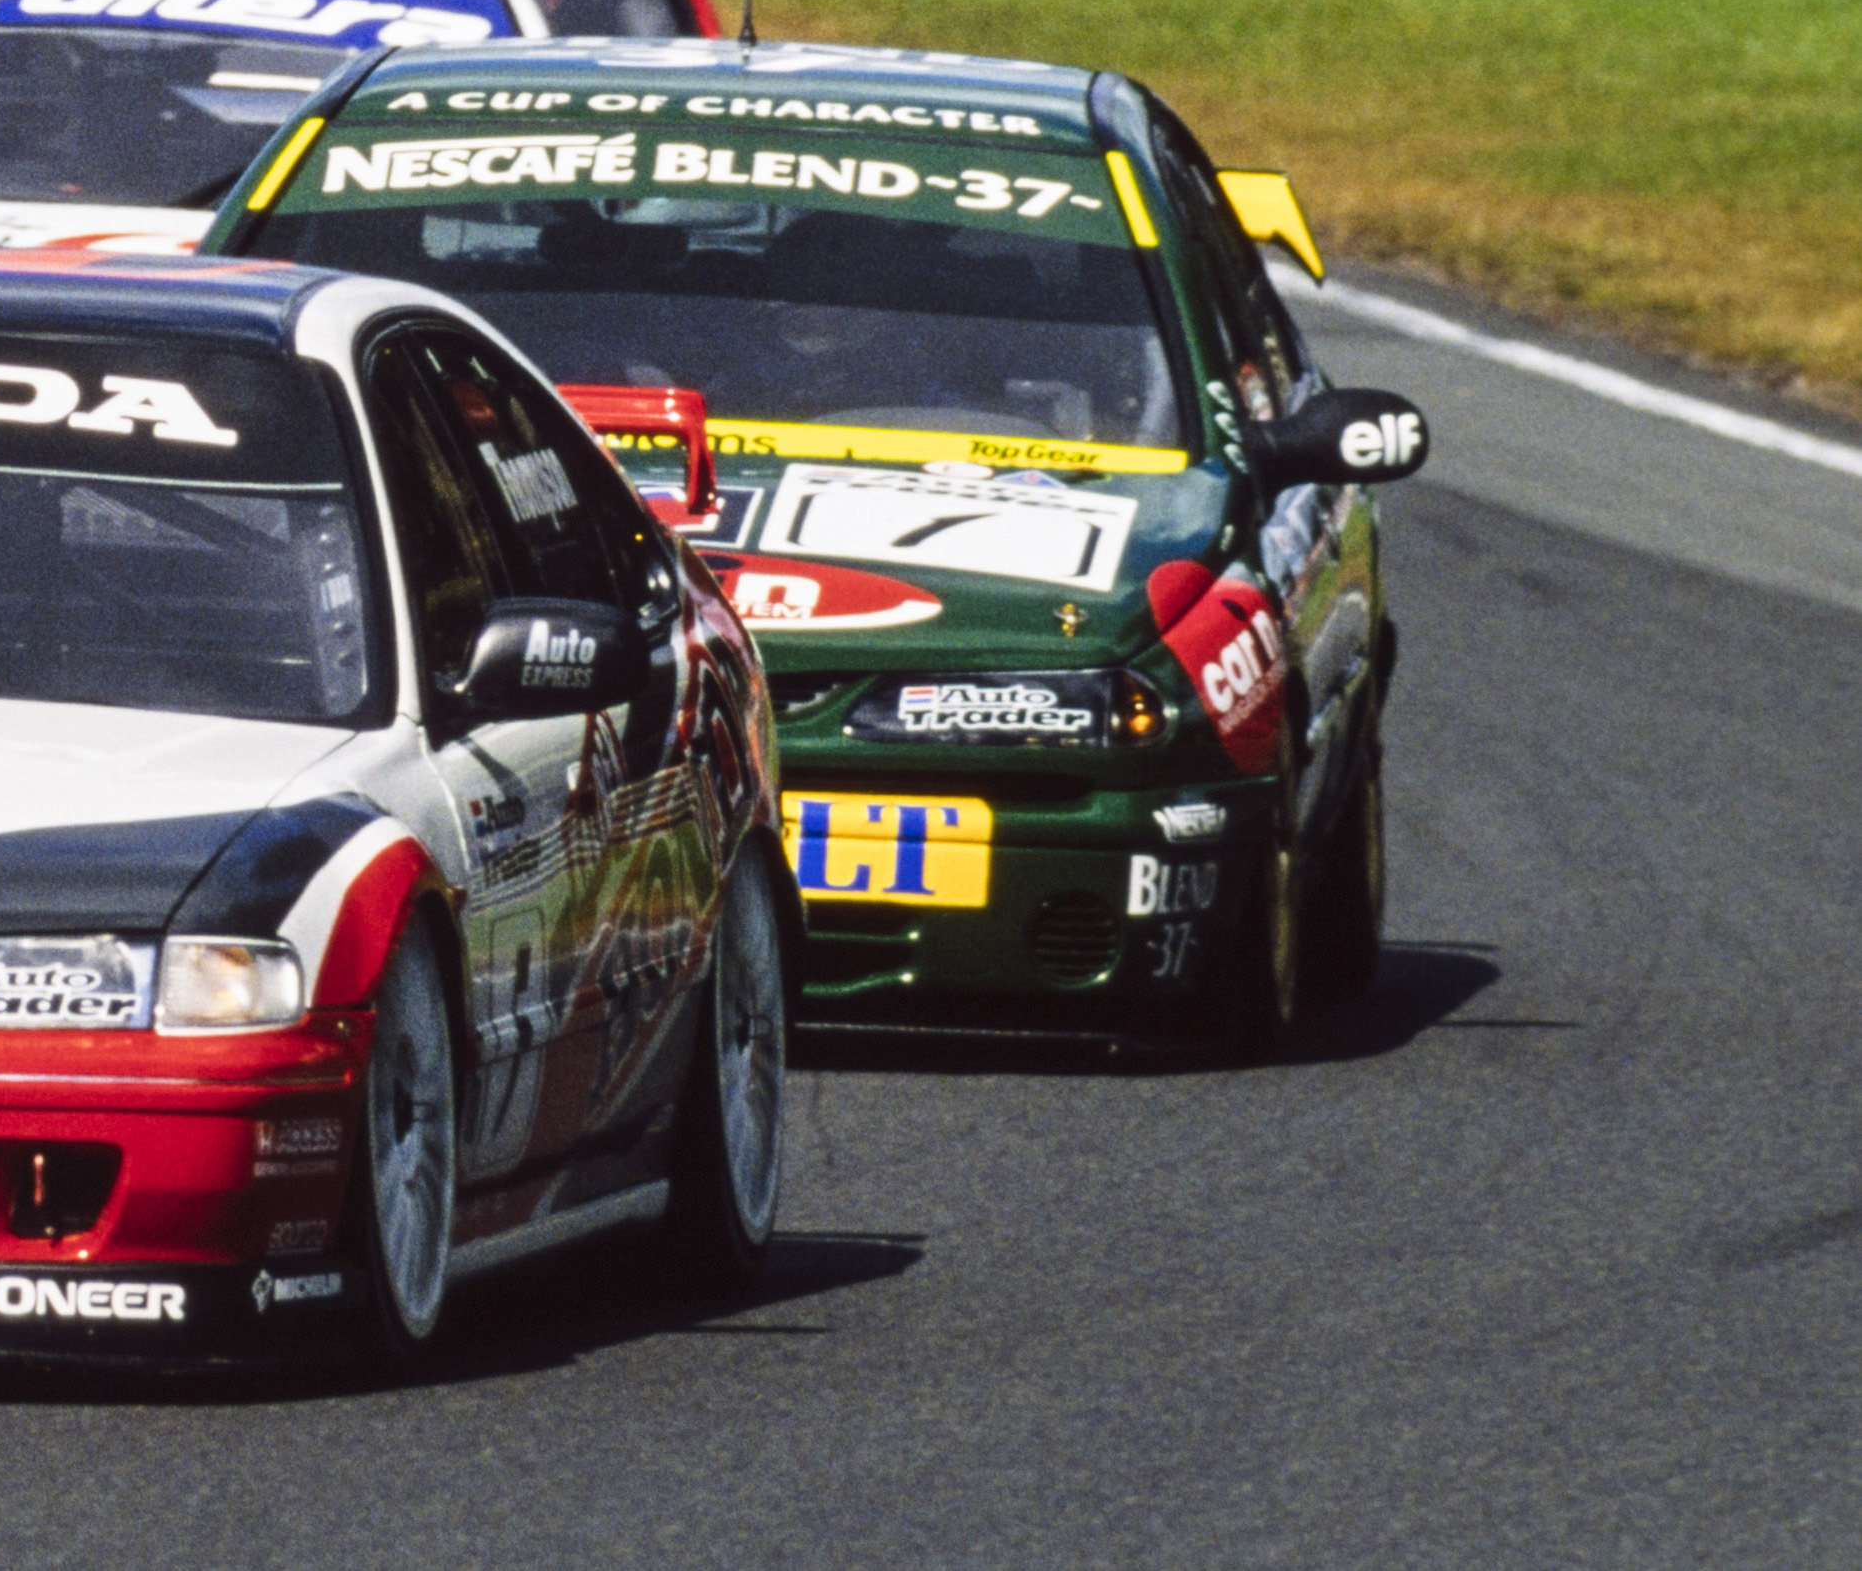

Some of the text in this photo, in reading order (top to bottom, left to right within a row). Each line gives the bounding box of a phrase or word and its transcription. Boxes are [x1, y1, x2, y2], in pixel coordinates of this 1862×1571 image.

[387, 90, 1041, 136] A CUP OF CHARACTER
[1340, 412, 1421, 467] elf
[891, 513, 1006, 547] 7
[525, 620, 597, 664] Auto
[521, 664, 594, 688] EXPRESS
[939, 685, 1055, 707] Auto
[905, 707, 1091, 730] Trader
